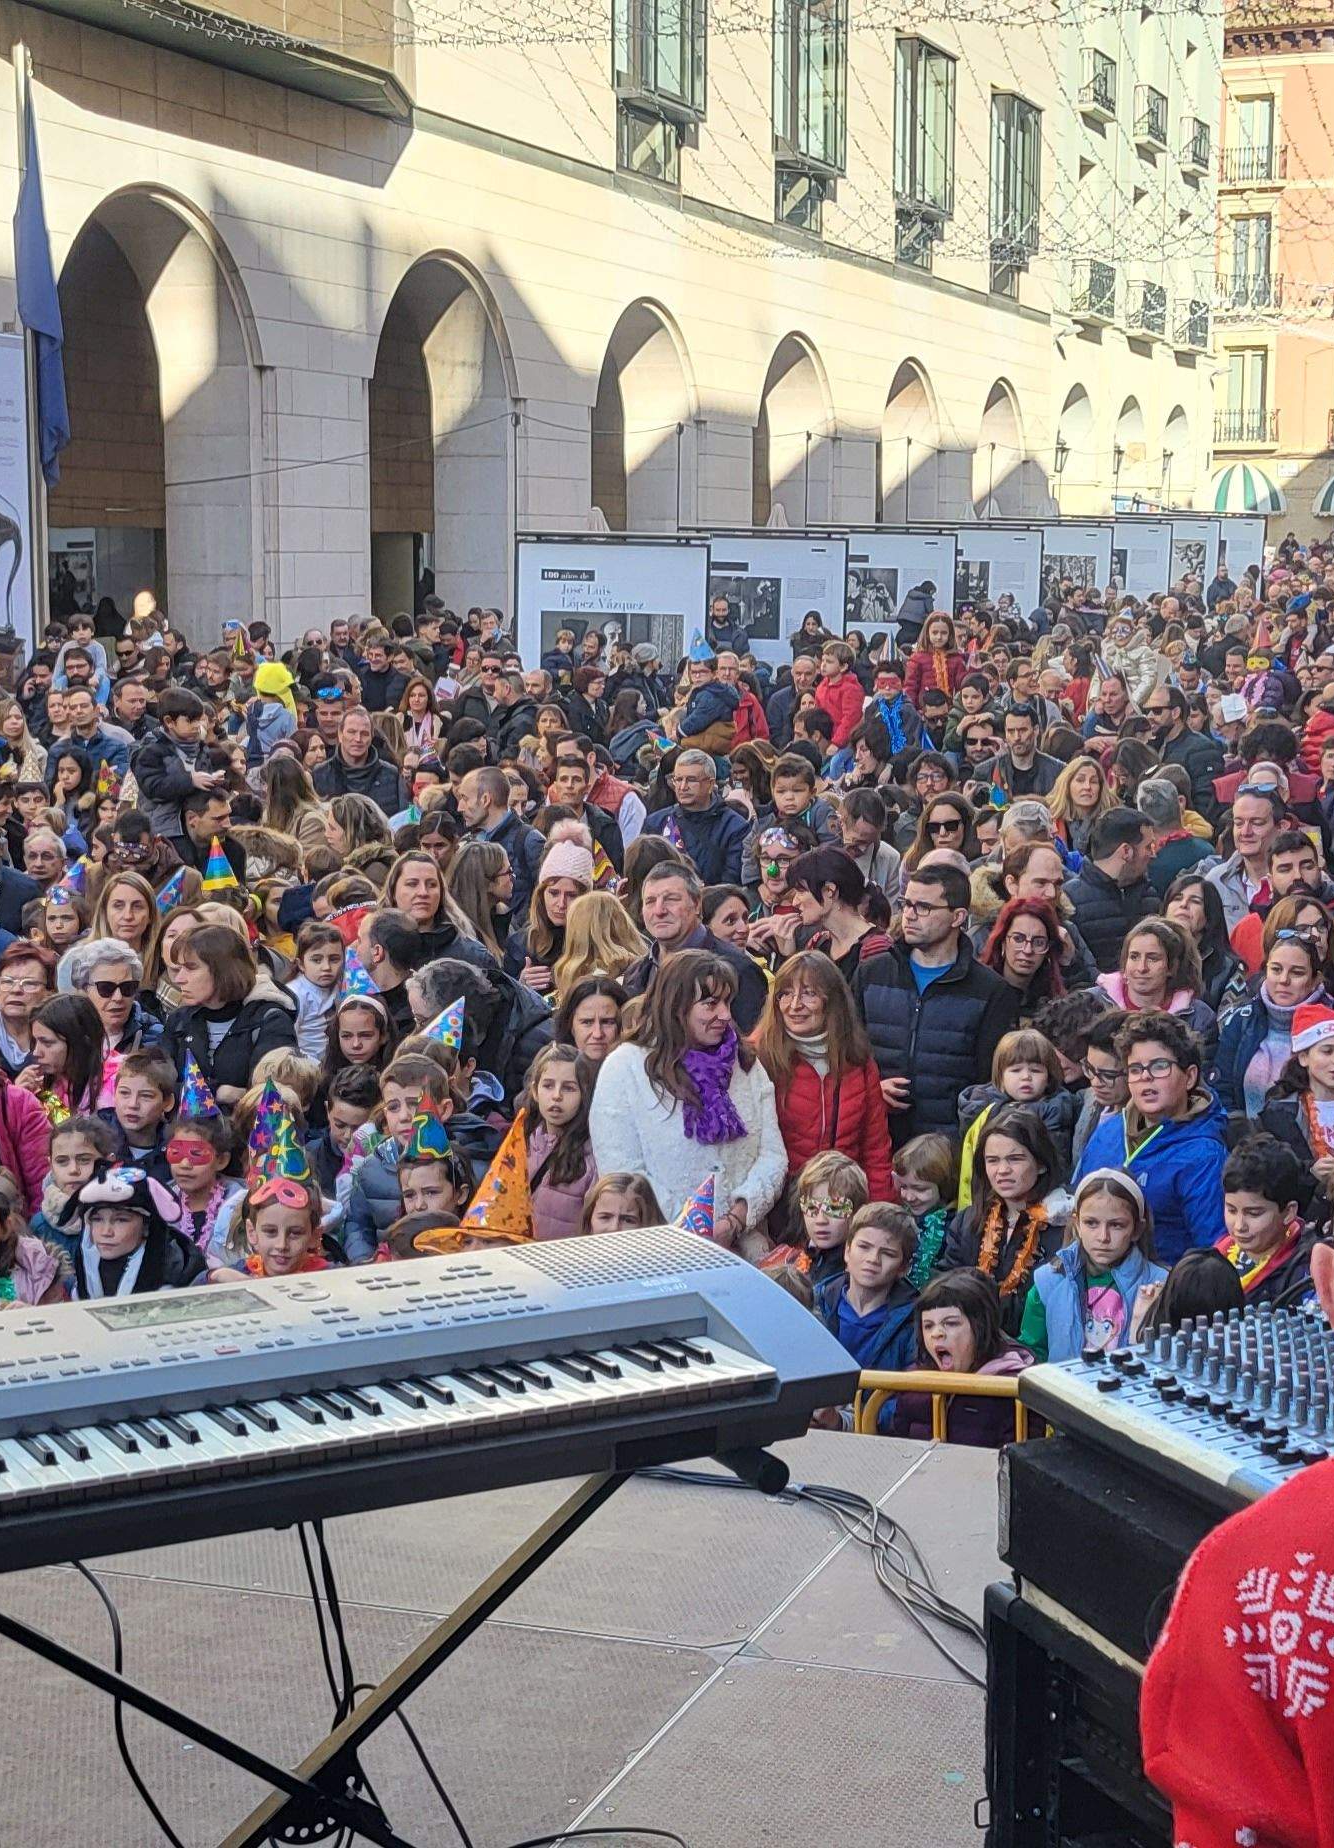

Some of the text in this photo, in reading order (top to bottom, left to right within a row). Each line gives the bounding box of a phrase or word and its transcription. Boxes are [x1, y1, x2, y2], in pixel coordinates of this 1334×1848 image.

[544, 571, 559, 579] 100
[561, 584, 611, 595] José Luis
[562, 597, 644, 611] López Vázquez
